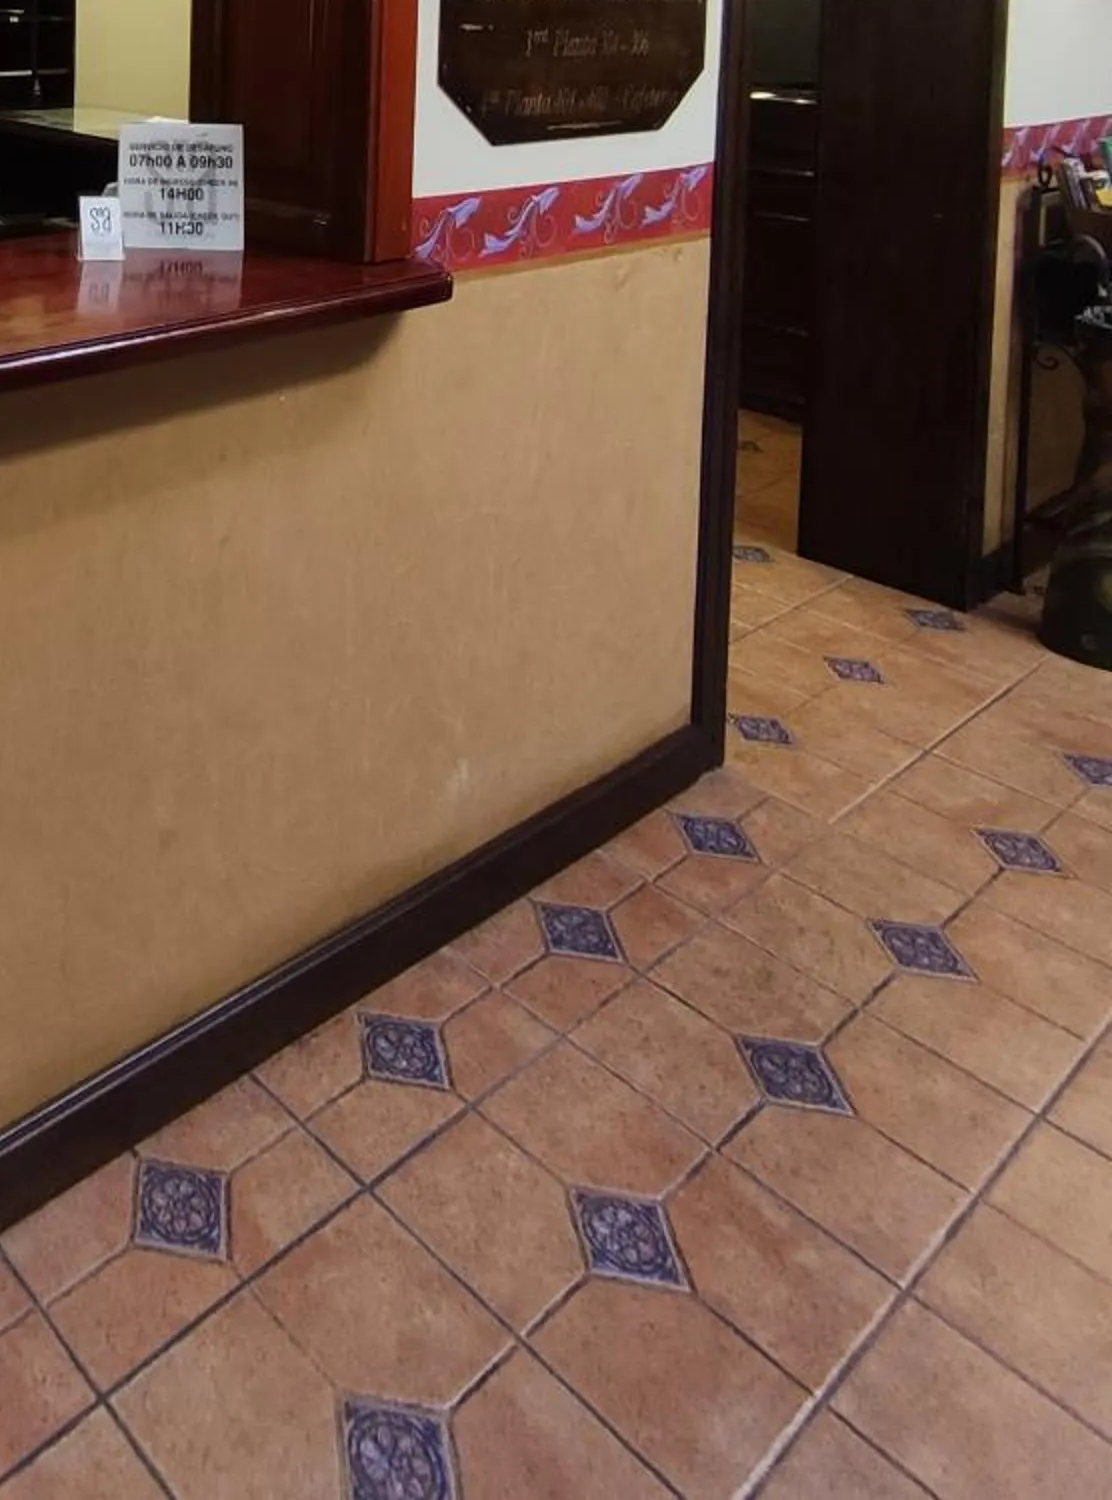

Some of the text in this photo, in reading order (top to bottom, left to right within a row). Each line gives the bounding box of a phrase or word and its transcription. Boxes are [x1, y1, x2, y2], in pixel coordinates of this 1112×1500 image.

[129, 154, 233, 169] 07h00 A 09h30
[161, 187, 204, 201] 14H00
